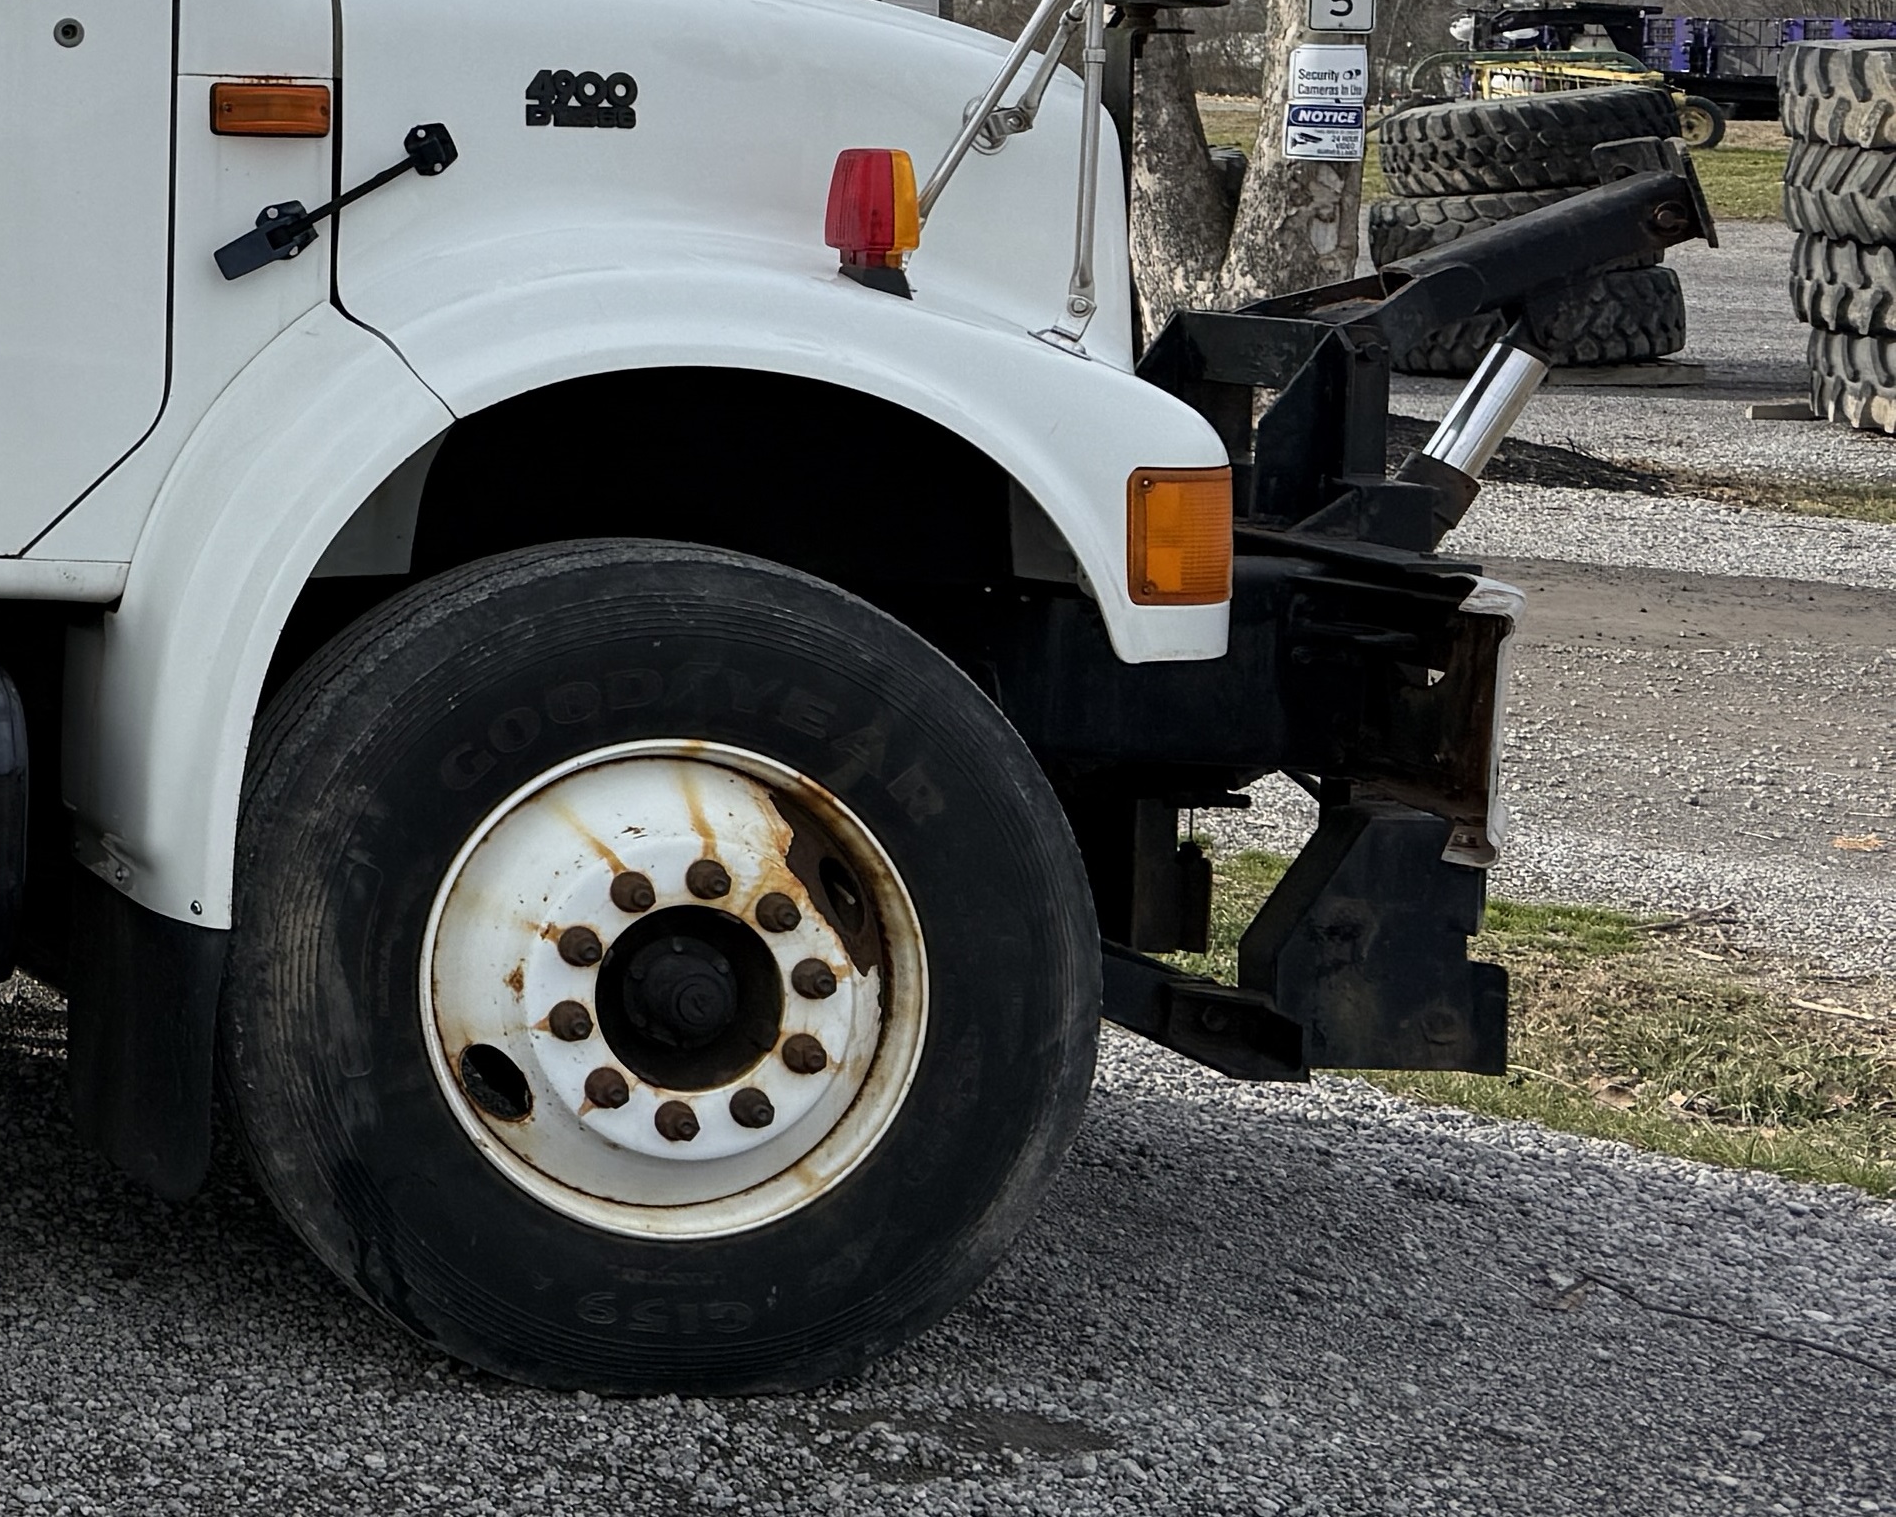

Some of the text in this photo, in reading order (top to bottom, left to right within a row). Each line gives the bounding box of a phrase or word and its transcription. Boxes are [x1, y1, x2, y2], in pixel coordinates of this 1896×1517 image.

[1298, 68, 1340, 83] Security
[525, 69, 638, 108] 4900
[1298, 84, 1339, 96] Cameras
[1298, 109, 1358, 124] NOTICE
[439, 662, 947, 826] GOODYEAR
